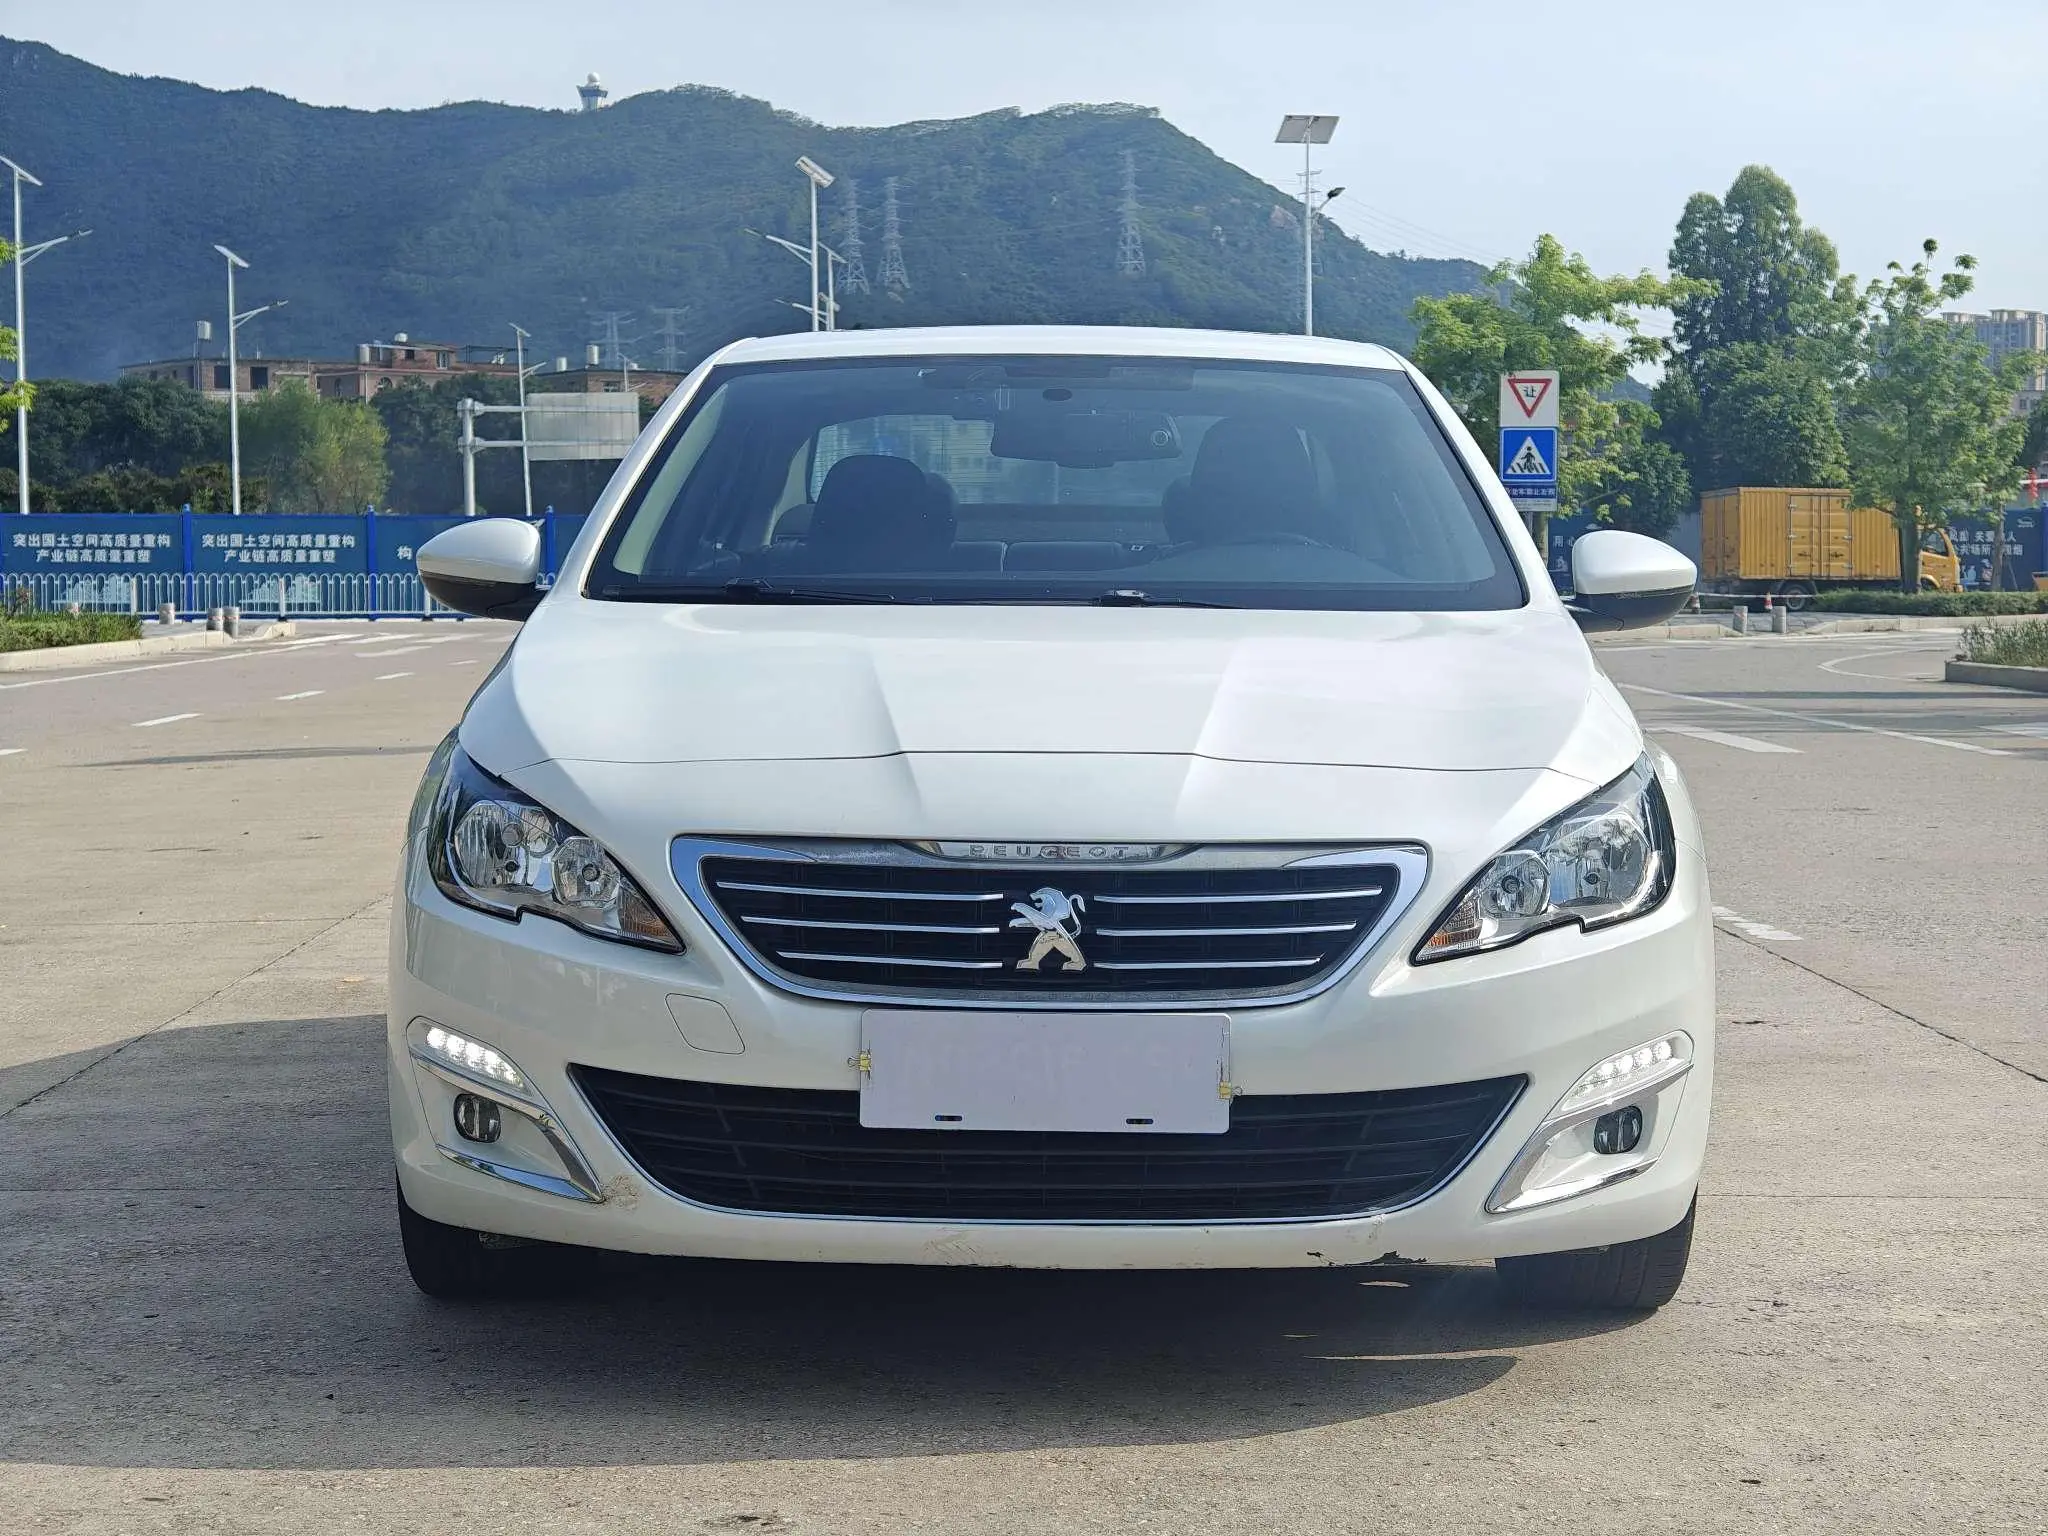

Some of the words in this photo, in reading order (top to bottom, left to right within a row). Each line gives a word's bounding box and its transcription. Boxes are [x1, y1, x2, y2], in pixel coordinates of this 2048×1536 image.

[1523, 385, 1537, 398] 让
[13, 533, 171, 548] 突出国土空间高质量重构
[202, 534, 356, 548] 突出国土空间高质量重构
[969, 844, 1129, 859] PEUGEOT
